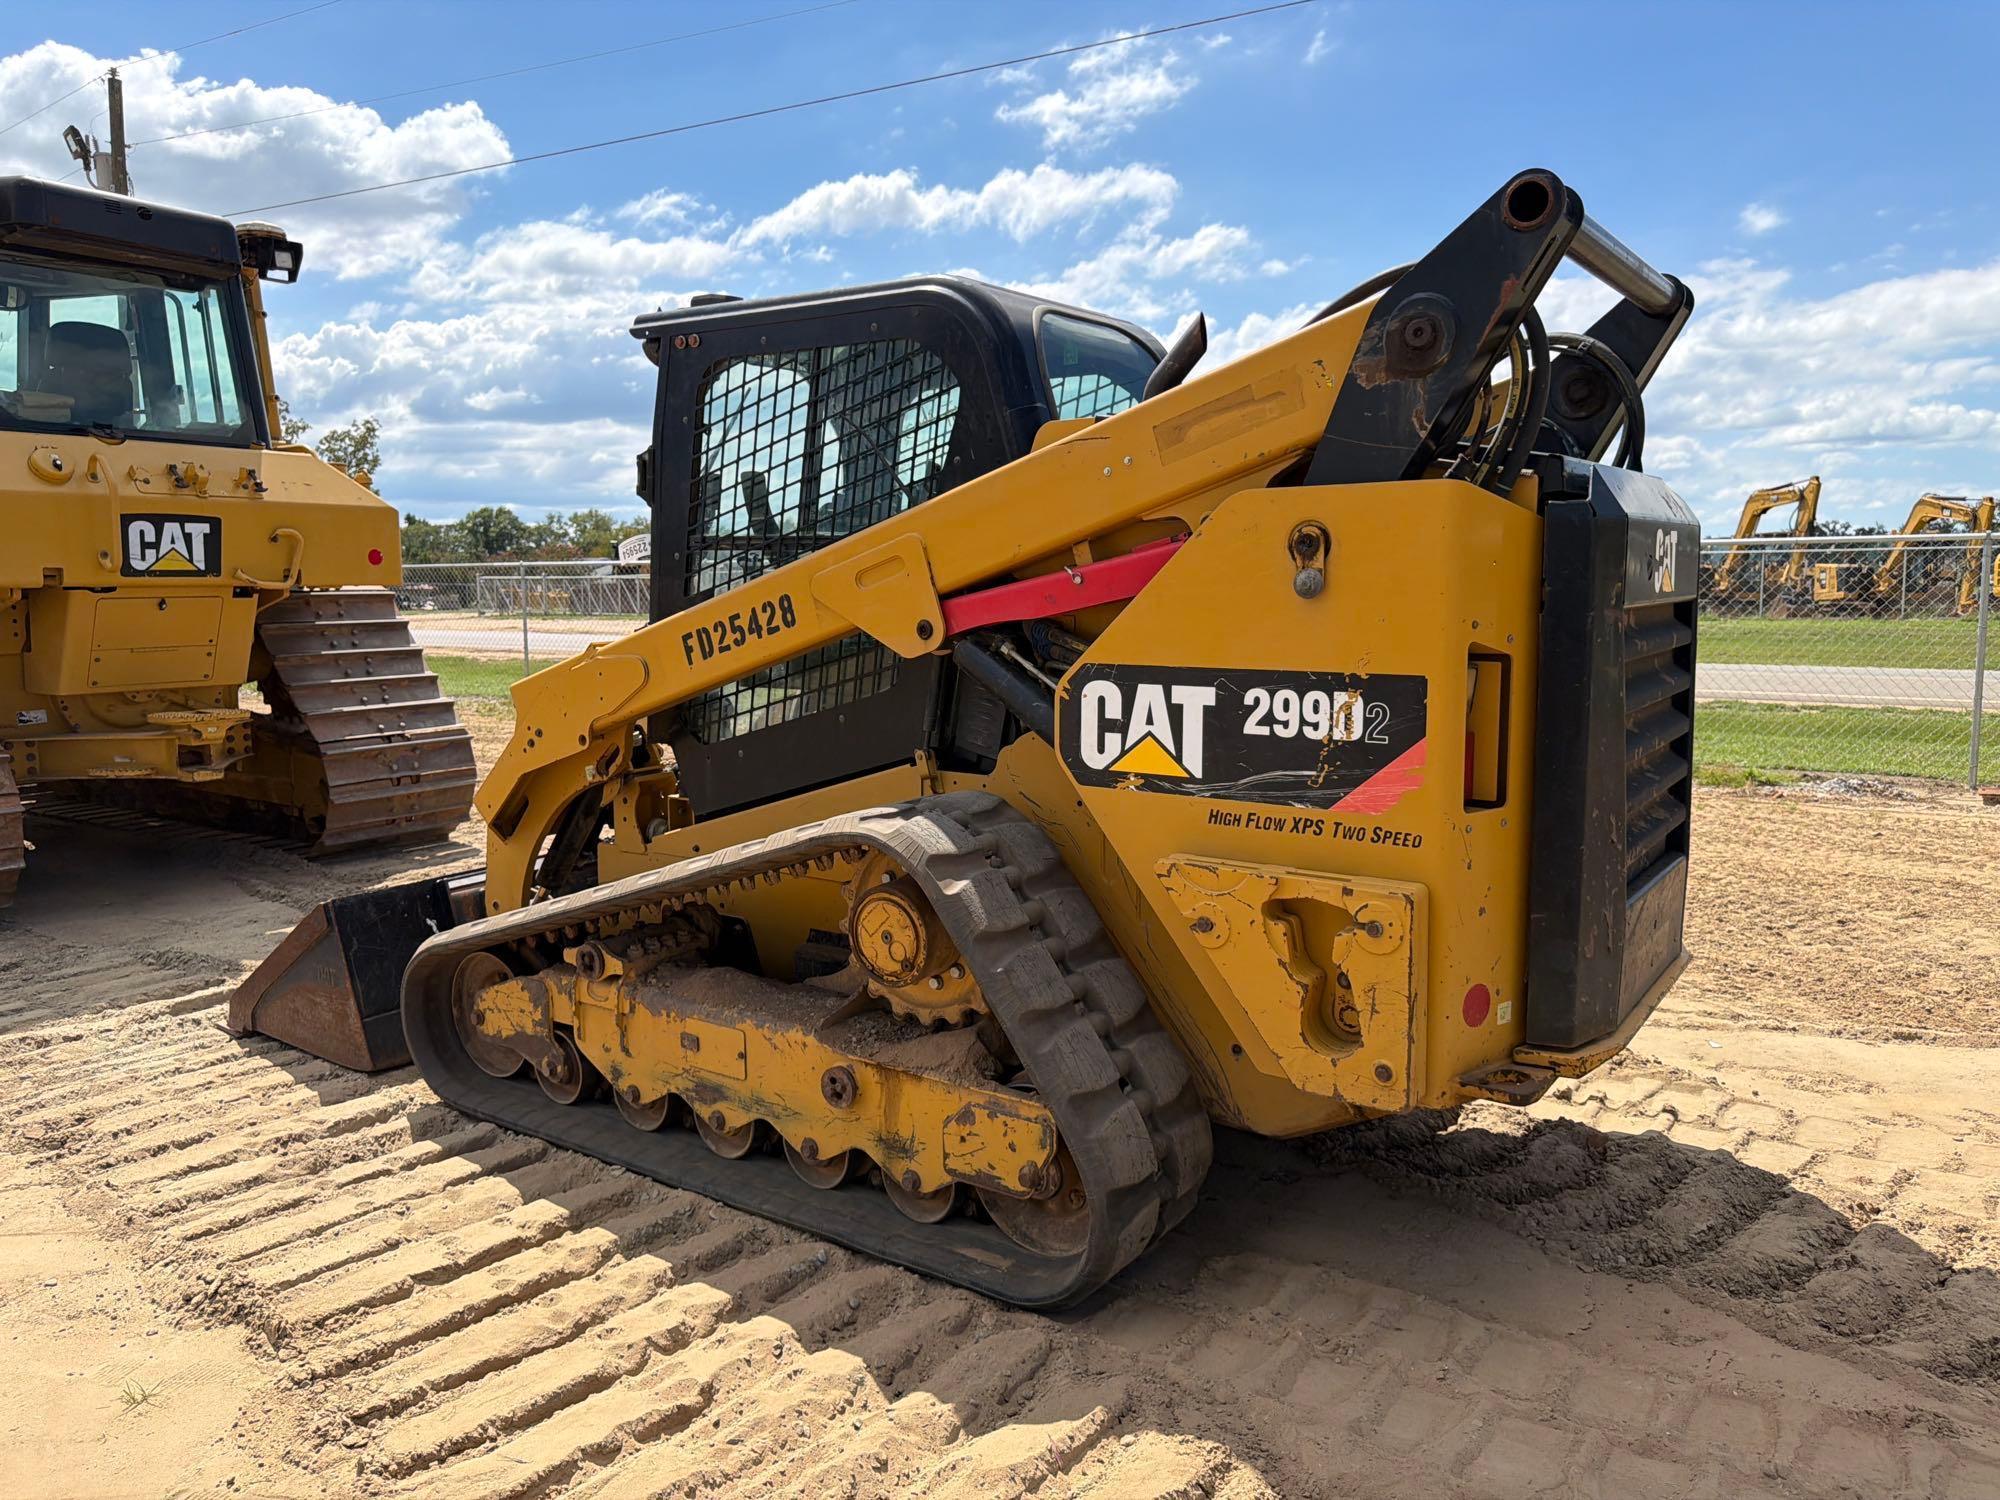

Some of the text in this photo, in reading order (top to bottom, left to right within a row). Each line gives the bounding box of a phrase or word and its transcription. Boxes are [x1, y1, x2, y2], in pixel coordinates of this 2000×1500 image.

[128, 520, 210, 571] CAT
[1655, 528, 1678, 594] CAT
[681, 593, 797, 666] FD25428
[1080, 679, 1390, 779] CAT 299D2
[1208, 808, 1423, 849] HIGH FLOW XPS TWO SPEED
